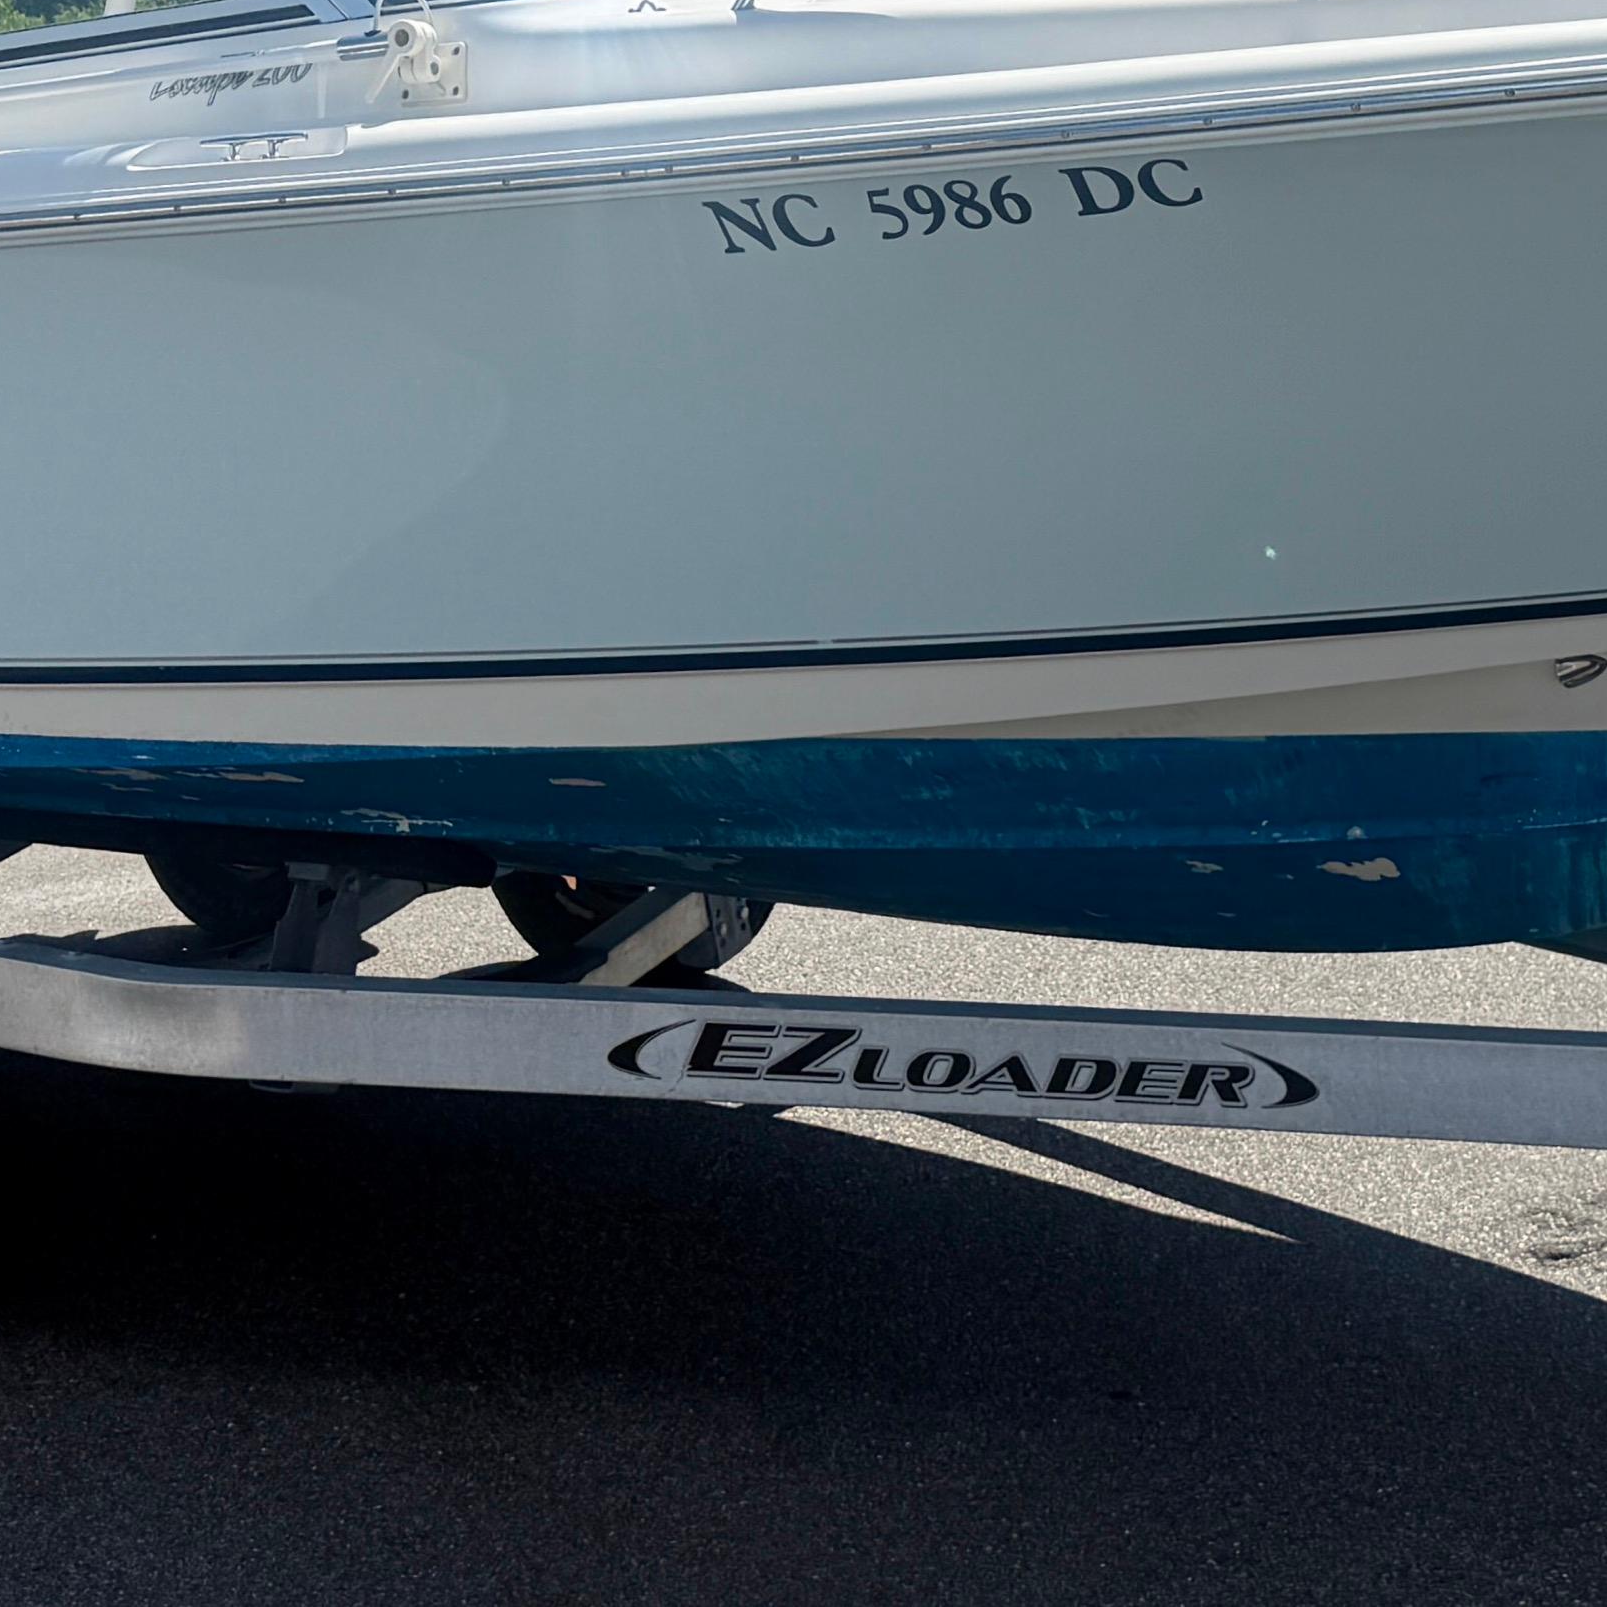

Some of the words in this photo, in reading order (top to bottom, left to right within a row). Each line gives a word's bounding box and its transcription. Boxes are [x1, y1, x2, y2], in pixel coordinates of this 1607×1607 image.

[701, 193, 835, 254] NC
[866, 175, 1033, 241] 5986
[1058, 159, 1204, 217] DC
